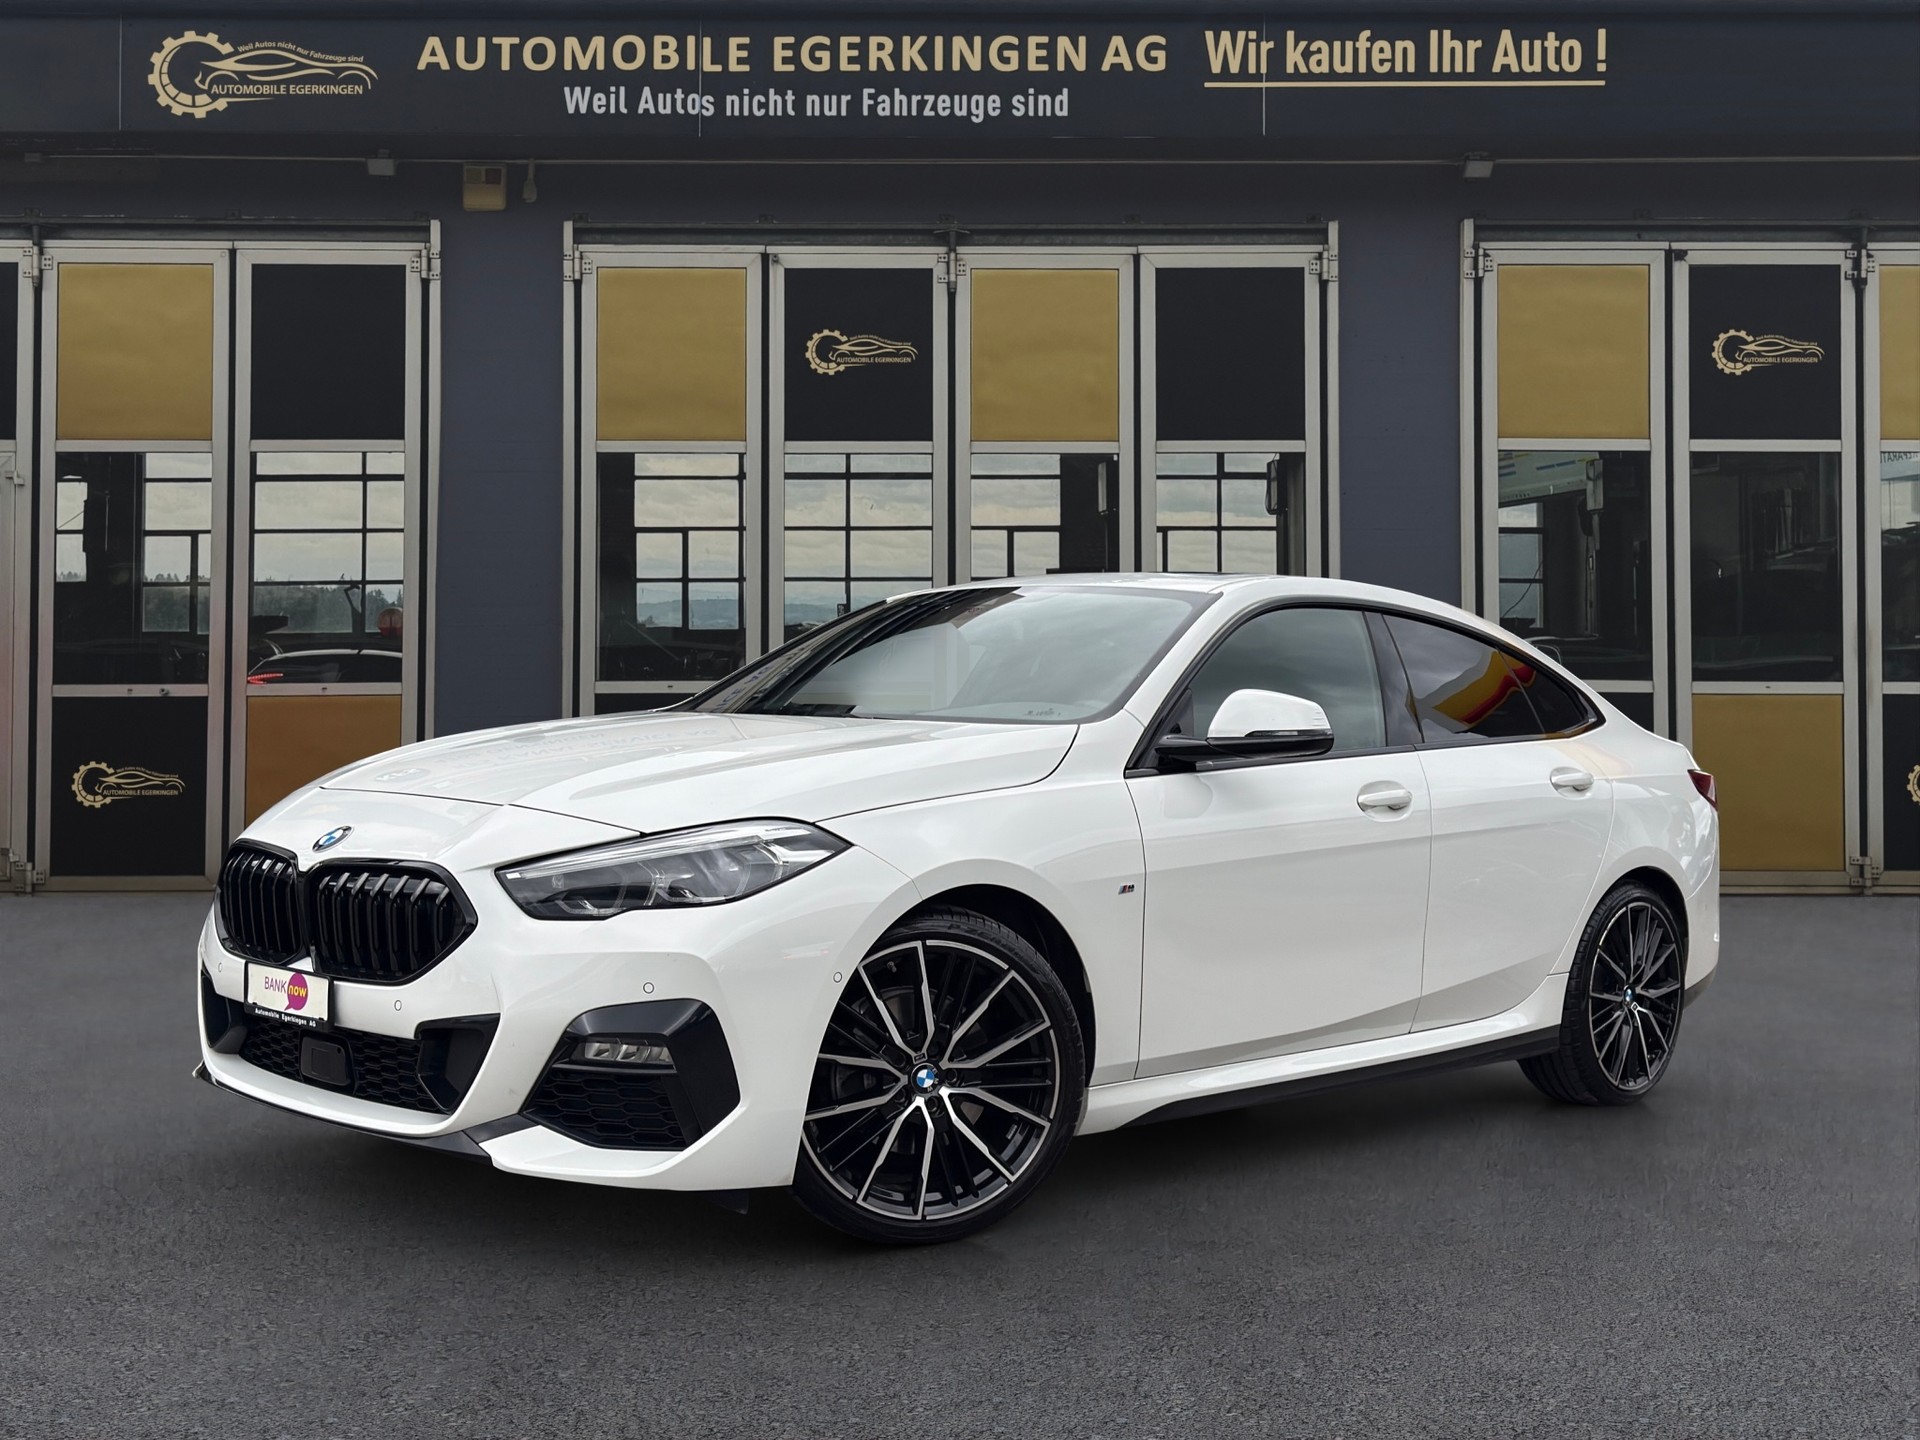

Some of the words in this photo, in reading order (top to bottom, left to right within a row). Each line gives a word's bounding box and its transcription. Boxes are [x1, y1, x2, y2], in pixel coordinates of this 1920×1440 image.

[237, 41, 254, 53] Weil
[254, 40, 276, 49] Autos
[277, 41, 297, 52] nicht
[296, 47, 310, 57] nur
[309, 50, 347, 63] Fahrzeuge
[347, 55, 365, 63] sind
[416, 35, 750, 72] AUTOMOBILE
[772, 34, 1087, 72] EGERKINGEN
[1100, 34, 1168, 72] AG
[1204, 30, 1274, 74] Wir
[1285, 29, 1416, 74] kaufen
[1429, 29, 1482, 73] Ihr
[1491, 28, 1583, 73] Auto
[1596, 27, 1607, 72] !
[210, 84, 287, 95] AUTOMOBILE
[289, 84, 363, 95] EGERKINGEN
[564, 86, 627, 114] Weil
[637, 88, 715, 116] Autos
[725, 88, 796, 116] nicht
[805, 94, 851, 116] nur
[862, 87, 1001, 123] Fahrzeuge
[1011, 87, 1069, 117] sind
[264, 976, 287, 994] BANK
[288, 985, 307, 997] now
[255, 1008, 279, 1018] Automobile
[282, 1014, 307, 1025] Egerkingen
